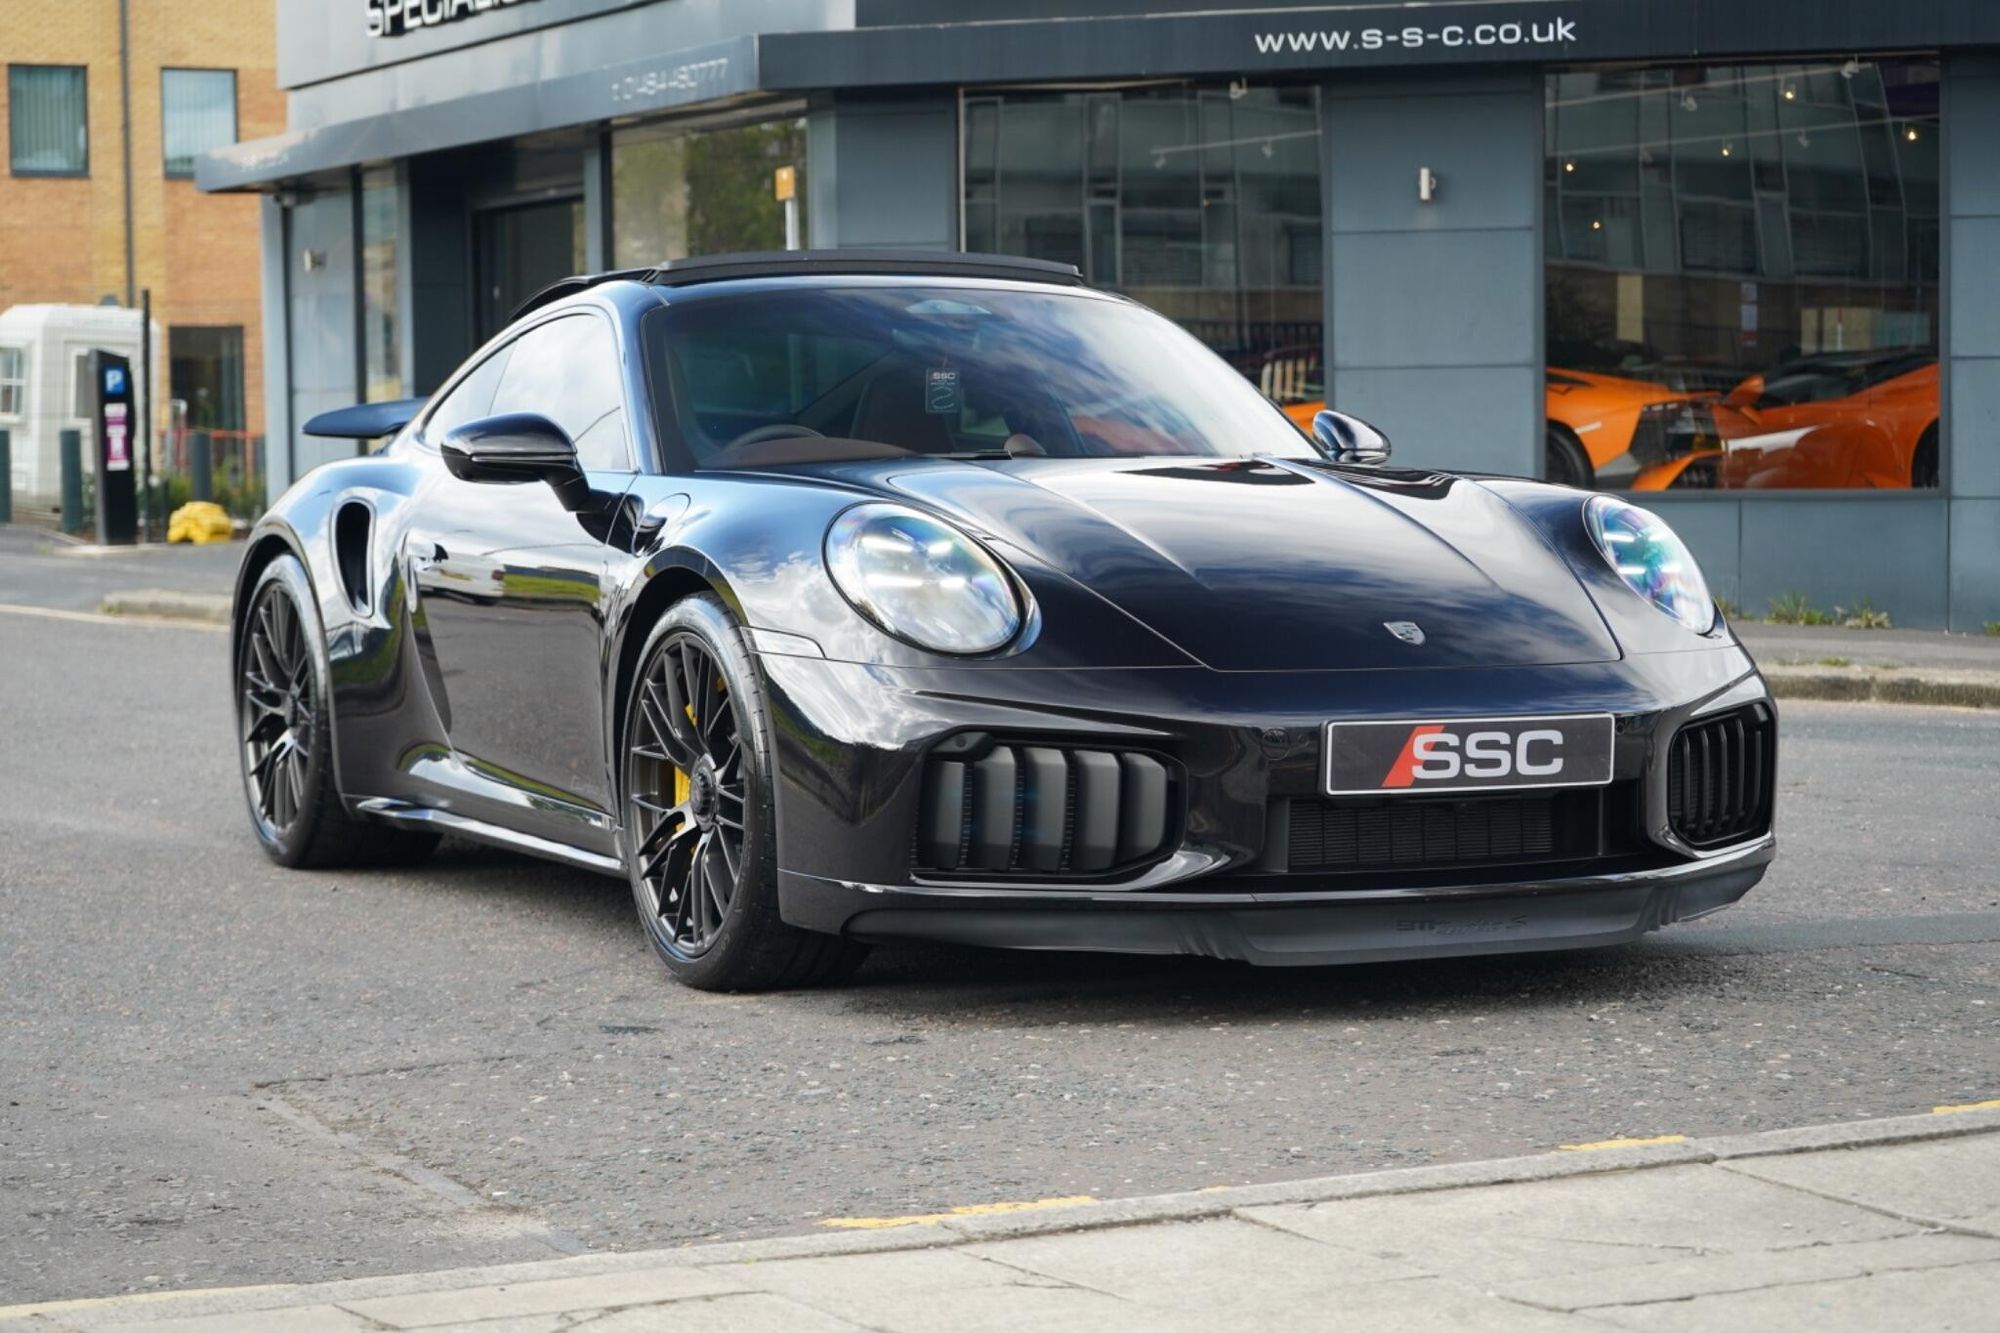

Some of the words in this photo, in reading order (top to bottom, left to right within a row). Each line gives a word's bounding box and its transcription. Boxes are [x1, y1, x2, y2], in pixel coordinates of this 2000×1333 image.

[1254, 17, 1577, 53] www.s-s-c.co.uk
[106, 369, 124, 392] P
[1411, 729, 1564, 780] SSC
